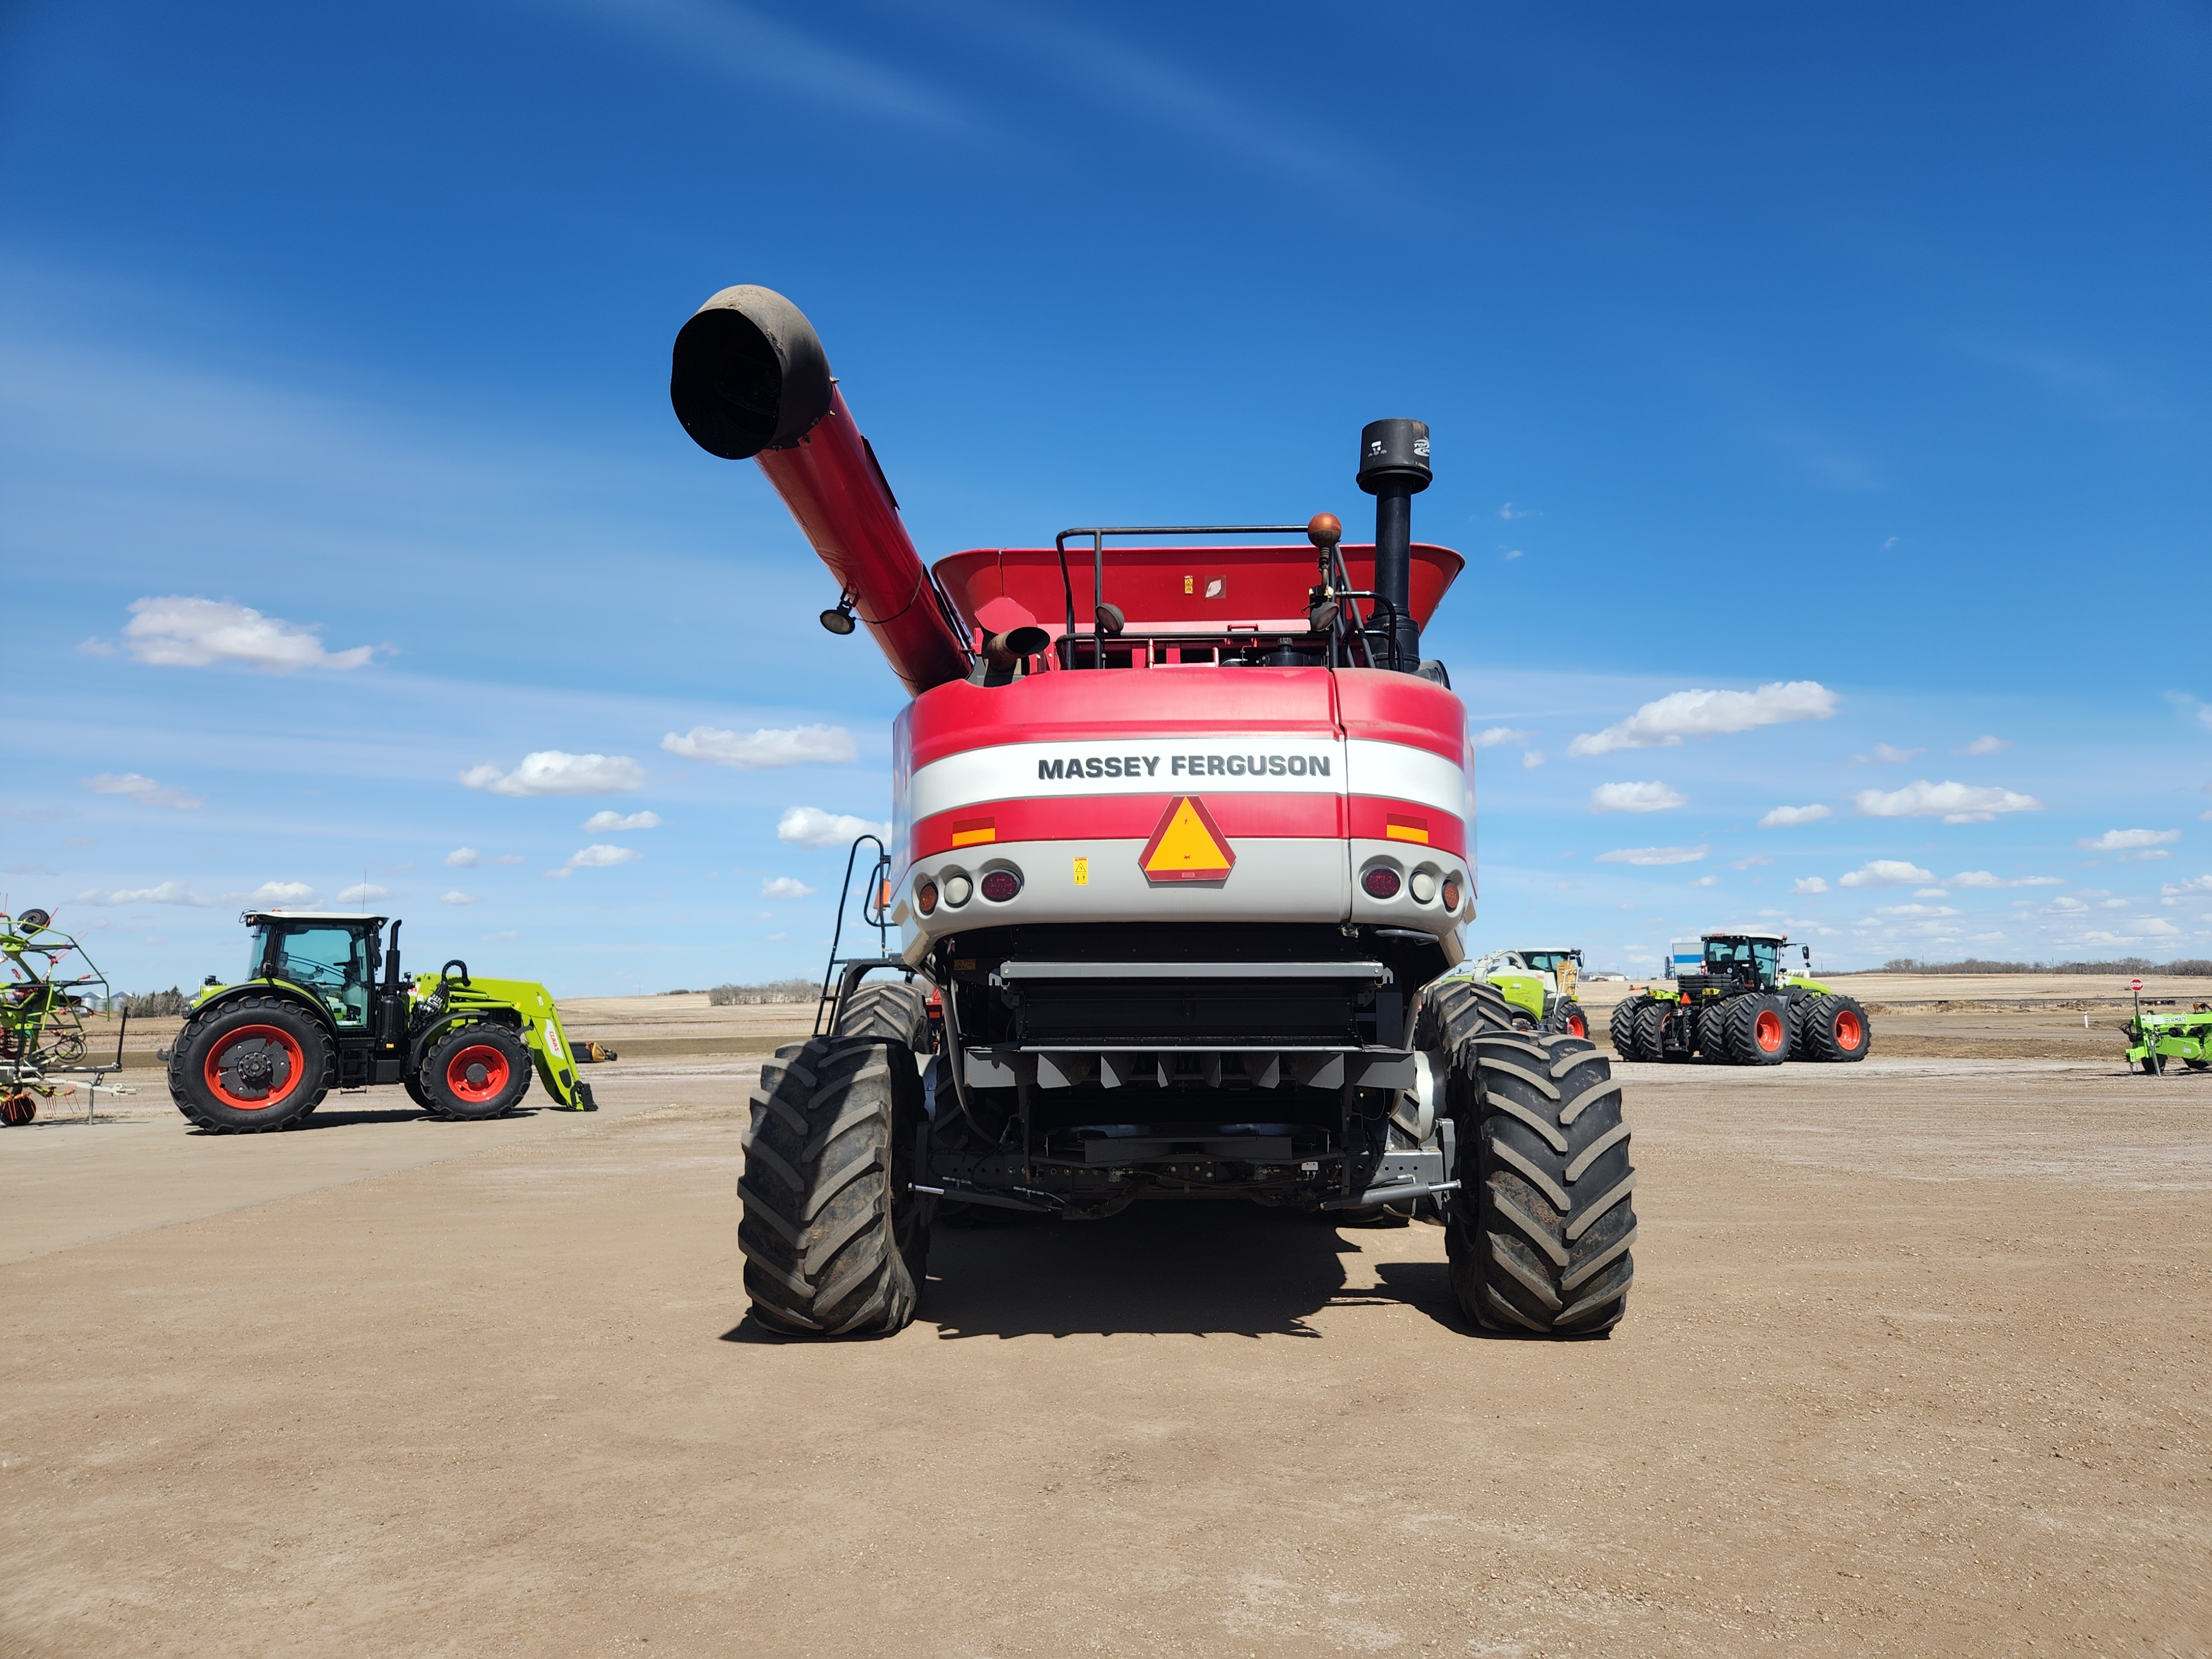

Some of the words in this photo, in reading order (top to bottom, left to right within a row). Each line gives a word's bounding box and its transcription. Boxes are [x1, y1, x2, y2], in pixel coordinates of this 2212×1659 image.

[1038, 756, 1161, 780] MASSEY
[1171, 755, 1332, 776] FERGUSON
[549, 1031, 560, 1051] CLAAS
